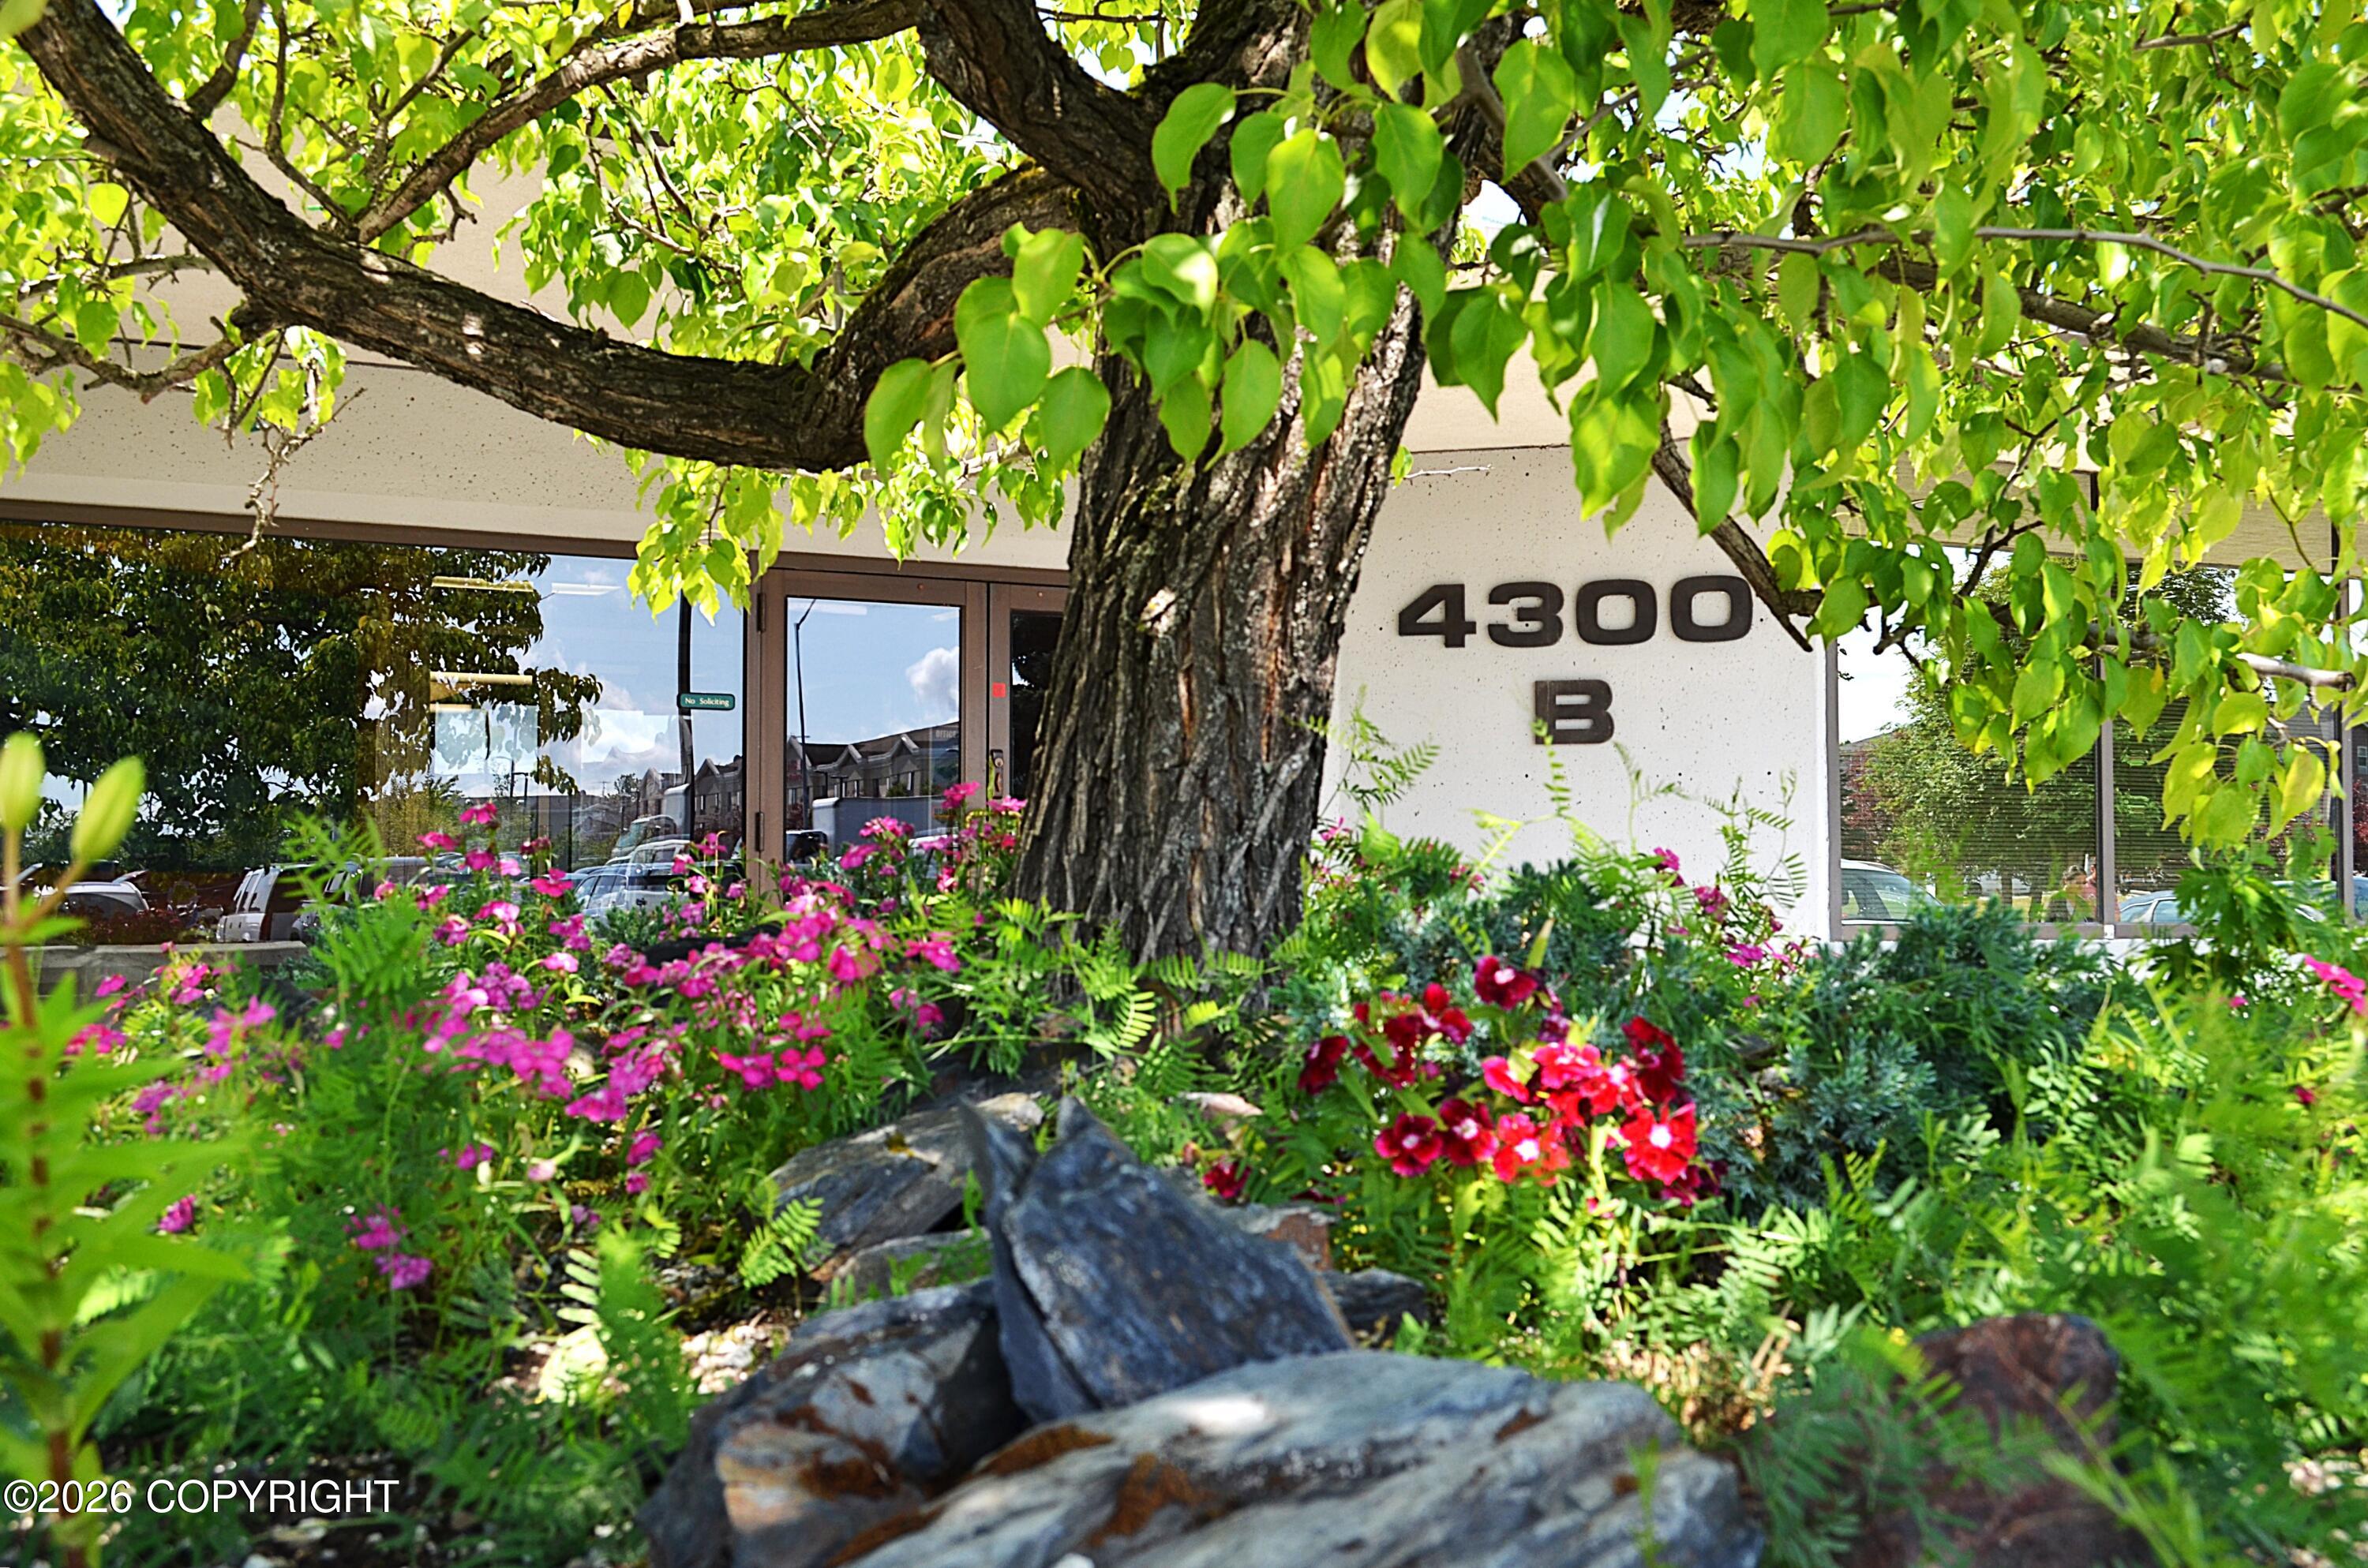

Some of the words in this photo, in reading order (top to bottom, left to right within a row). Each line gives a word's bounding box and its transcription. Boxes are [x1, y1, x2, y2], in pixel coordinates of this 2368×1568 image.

[1398, 574, 1754, 649] 4300
[699, 698, 729, 707] Soliciting
[1534, 679, 1615, 745] B
